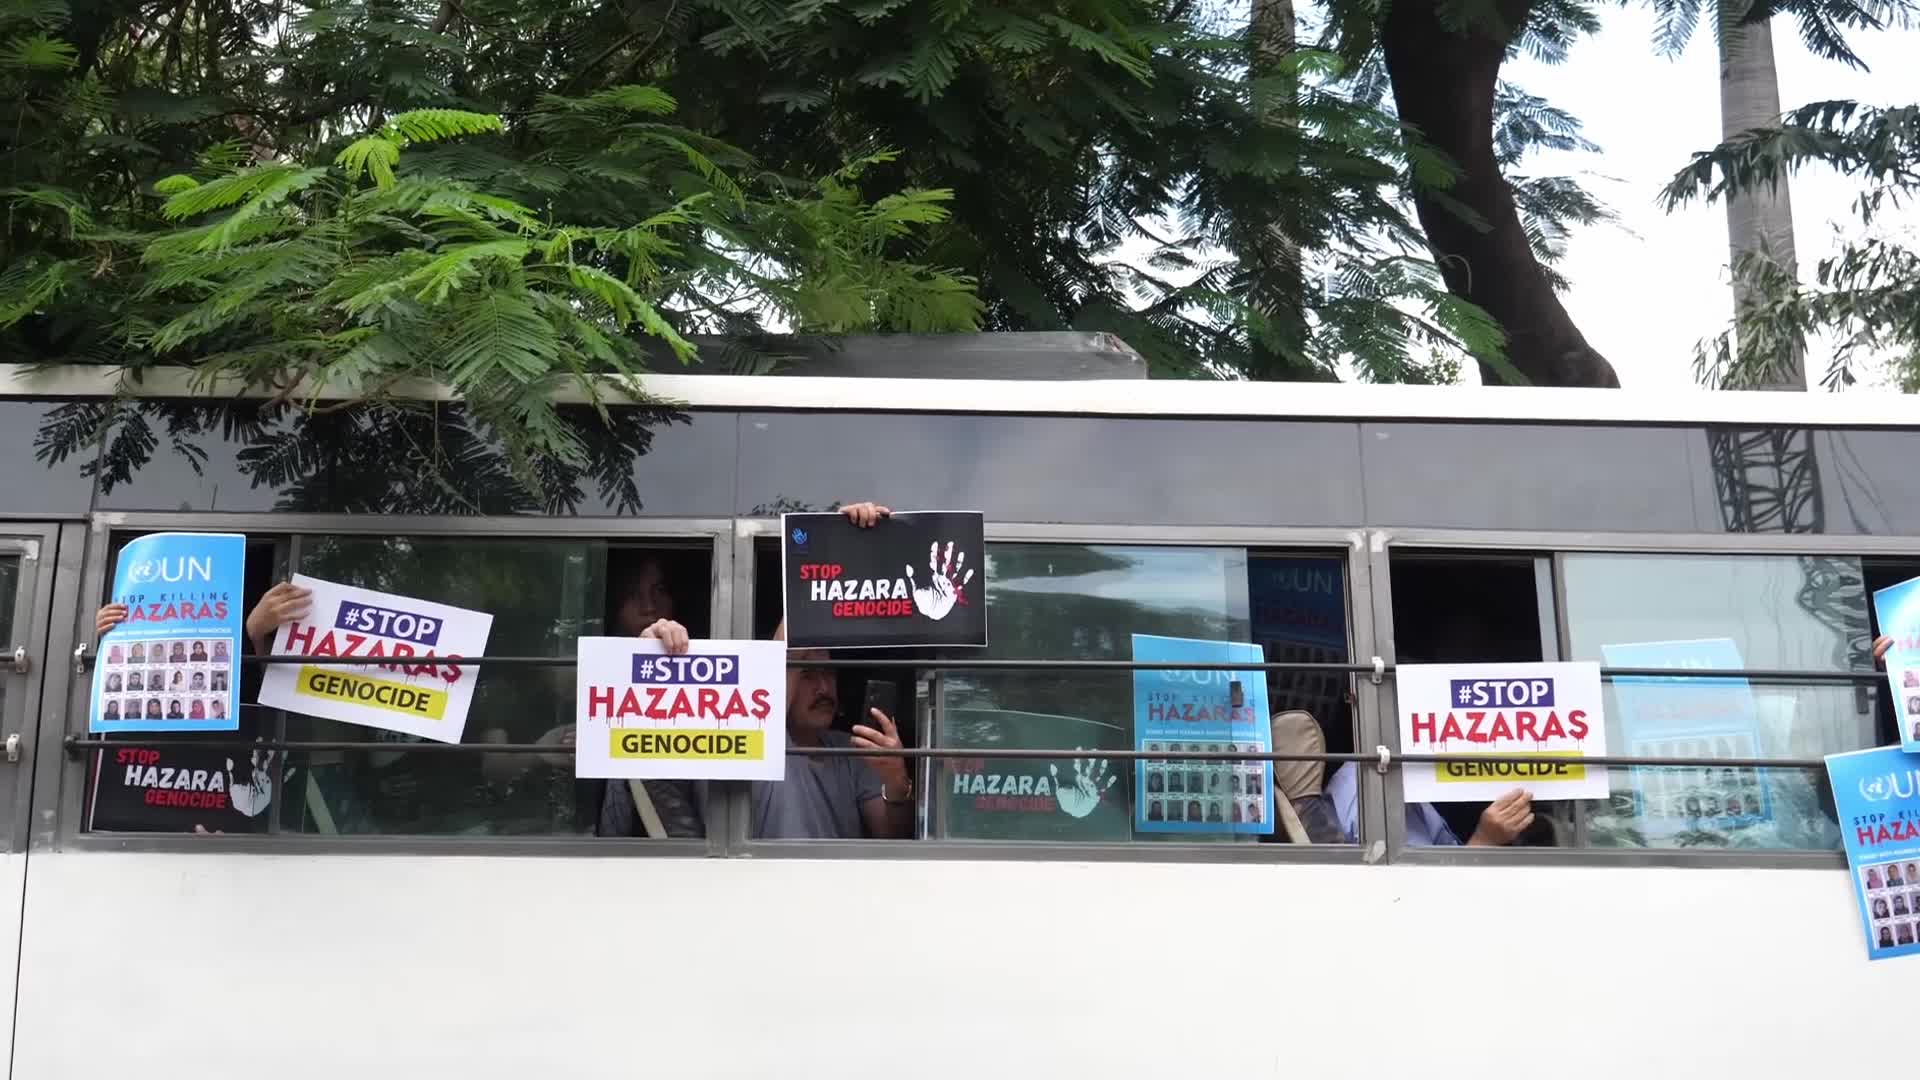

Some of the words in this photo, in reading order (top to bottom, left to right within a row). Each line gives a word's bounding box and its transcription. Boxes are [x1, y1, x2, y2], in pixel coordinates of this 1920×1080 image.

[161, 555, 212, 582] UN
[801, 564, 841, 579] STOP
[113, 594, 145, 604] TOP
[160, 592, 230, 602] KILLING
[811, 578, 908, 601] HAZARA
[126, 602, 229, 622] AZARAS
[833, 600, 912, 616] GENOCIDE
[344, 607, 437, 641] #STOP
[284, 622, 465, 685] HAZARAS
[640, 656, 733, 682] #STOP
[309, 673, 431, 712] GENOCIDE
[588, 686, 772, 721] HAZARAS
[1459, 680, 1549, 706] #STOP
[1411, 710, 1590, 744] HAZARAS
[622, 734, 747, 754] GENOCIDE
[116, 749, 160, 764] STOP
[1446, 759, 1568, 777] GENOCIDE
[124, 765, 225, 793] HAZARA
[953, 774, 1051, 795] HAZARA
[144, 790, 227, 809] GENOCIDE
[1854, 813, 1885, 825] STOP
[1857, 819, 1920, 846] HAZA
